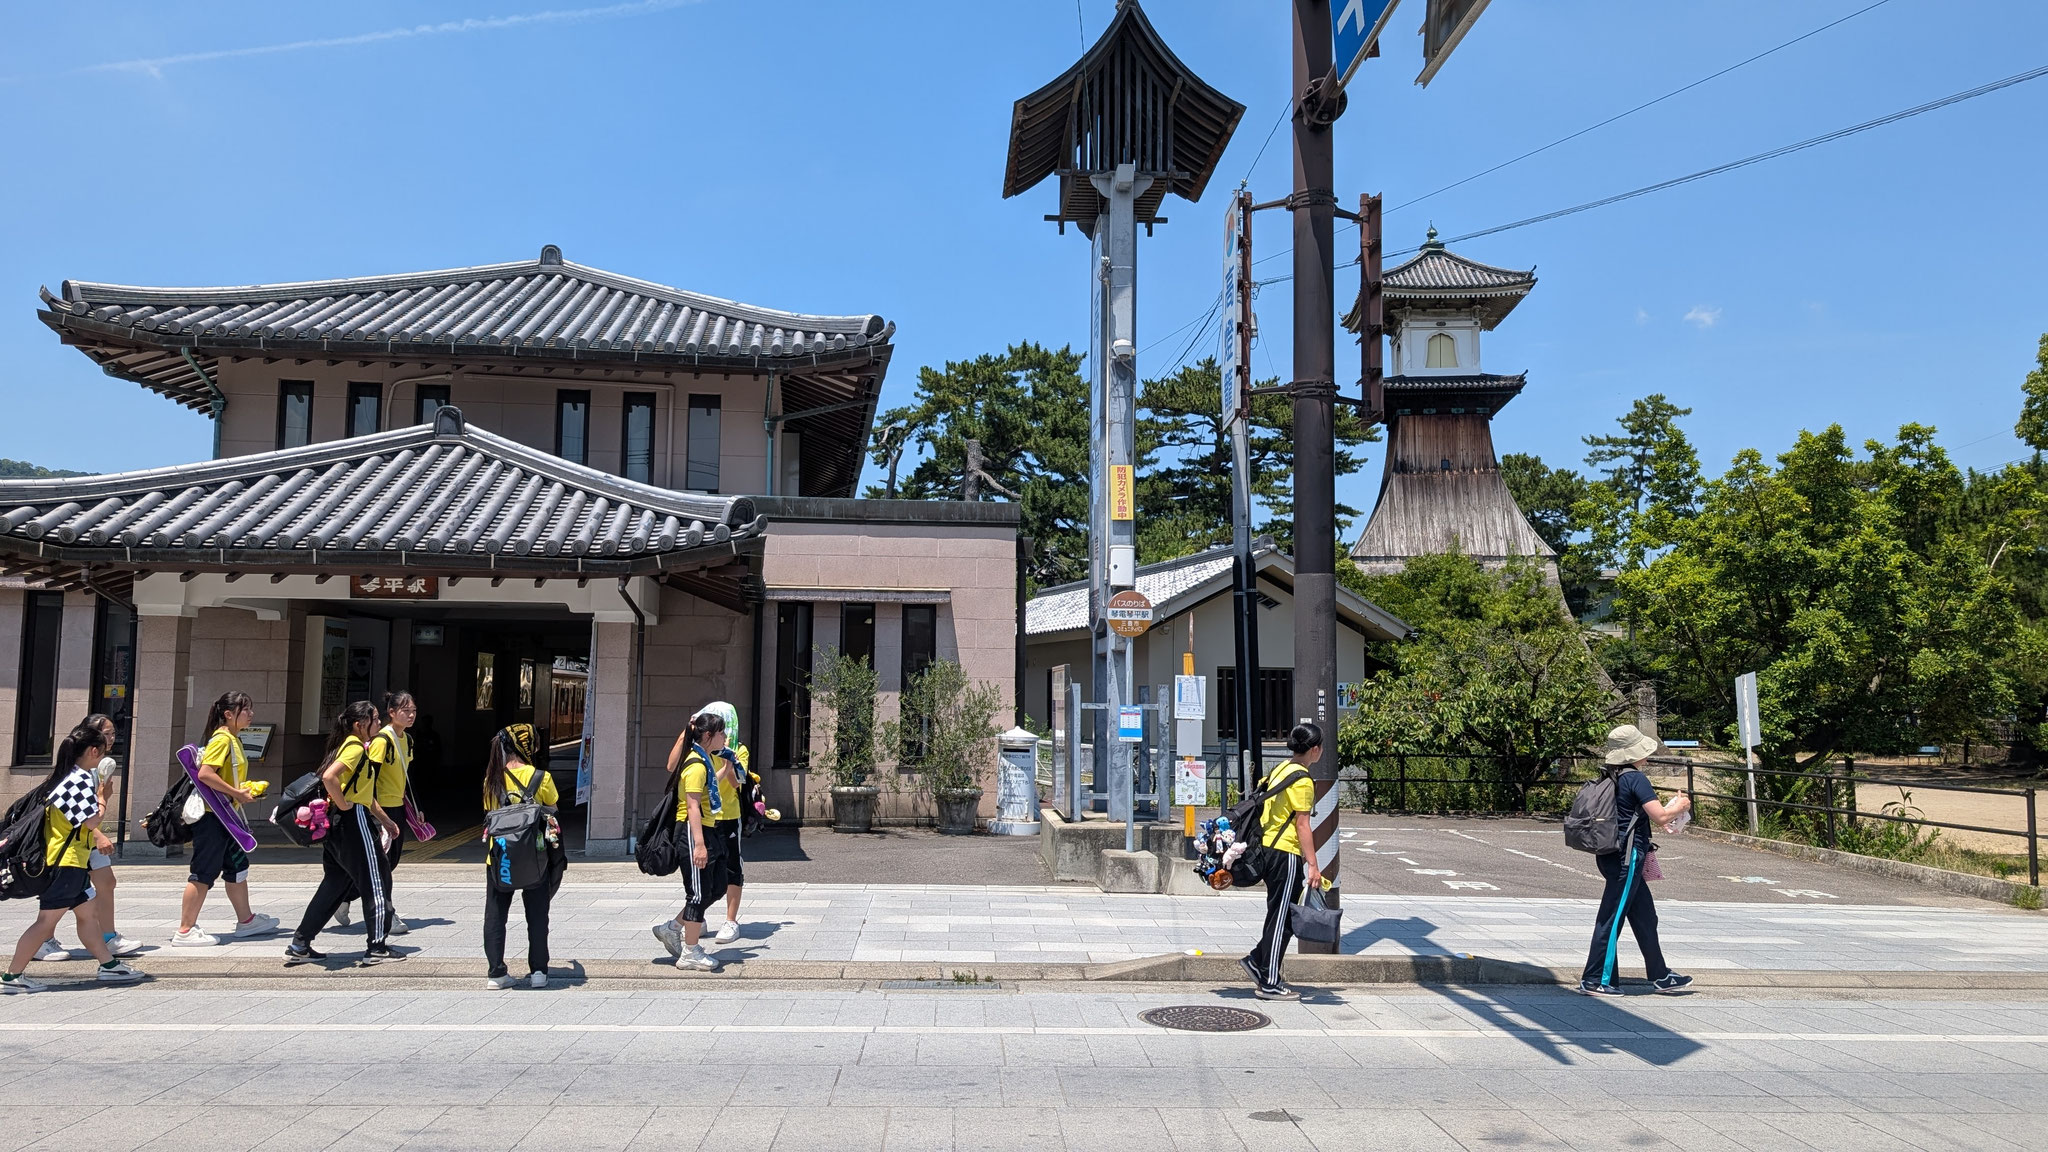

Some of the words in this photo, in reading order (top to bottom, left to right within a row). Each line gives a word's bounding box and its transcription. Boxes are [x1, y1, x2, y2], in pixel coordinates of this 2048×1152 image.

[1117, 466, 1127, 519] 防犯カメラ作動中
[1113, 600, 1146, 608] バスのりば
